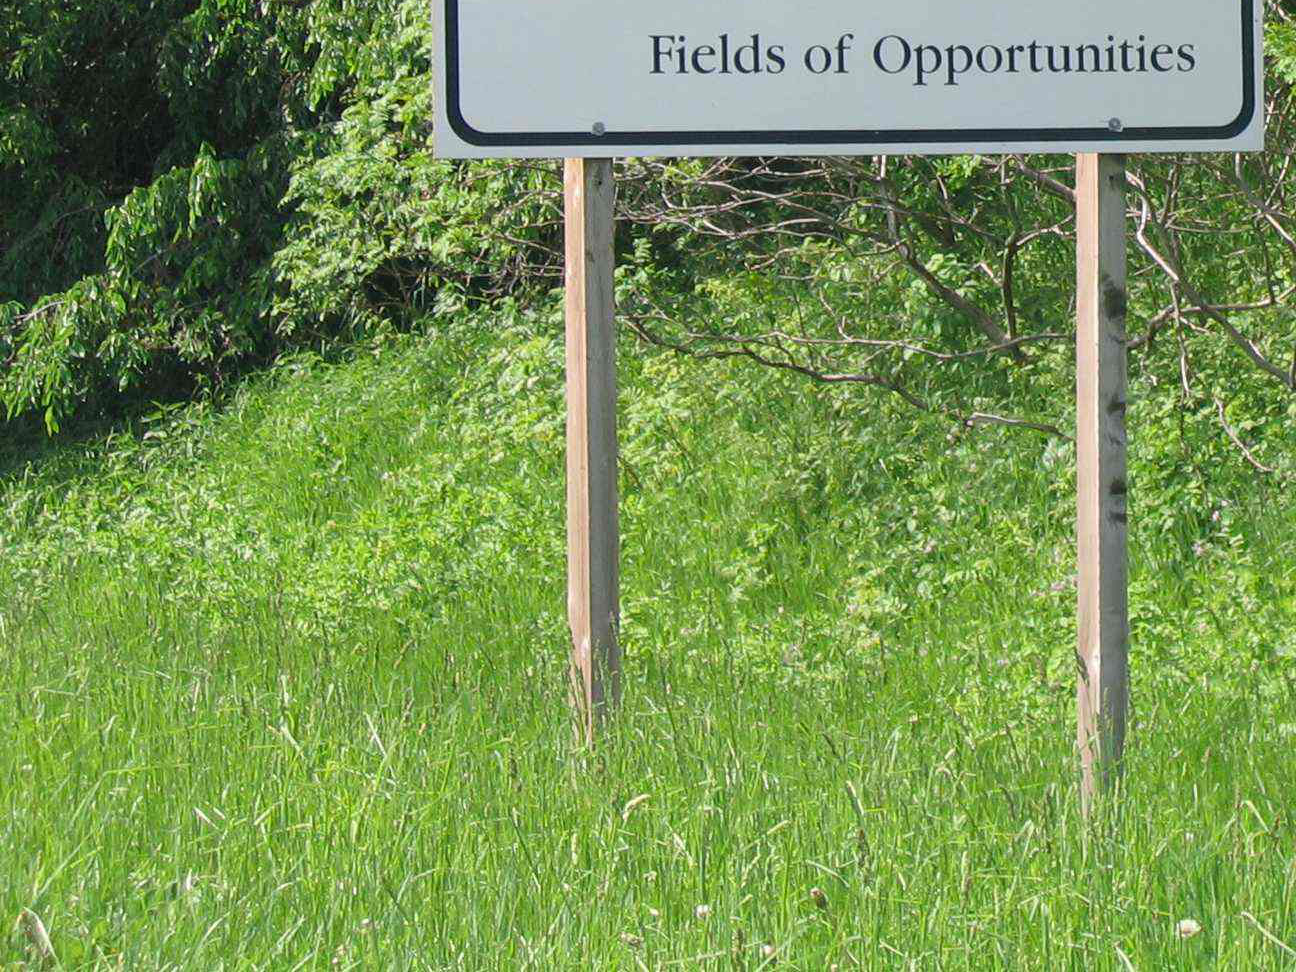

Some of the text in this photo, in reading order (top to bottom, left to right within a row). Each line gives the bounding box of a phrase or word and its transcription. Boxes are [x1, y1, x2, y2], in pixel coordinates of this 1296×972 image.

[649, 33, 1197, 86] Fields of Opportunities
